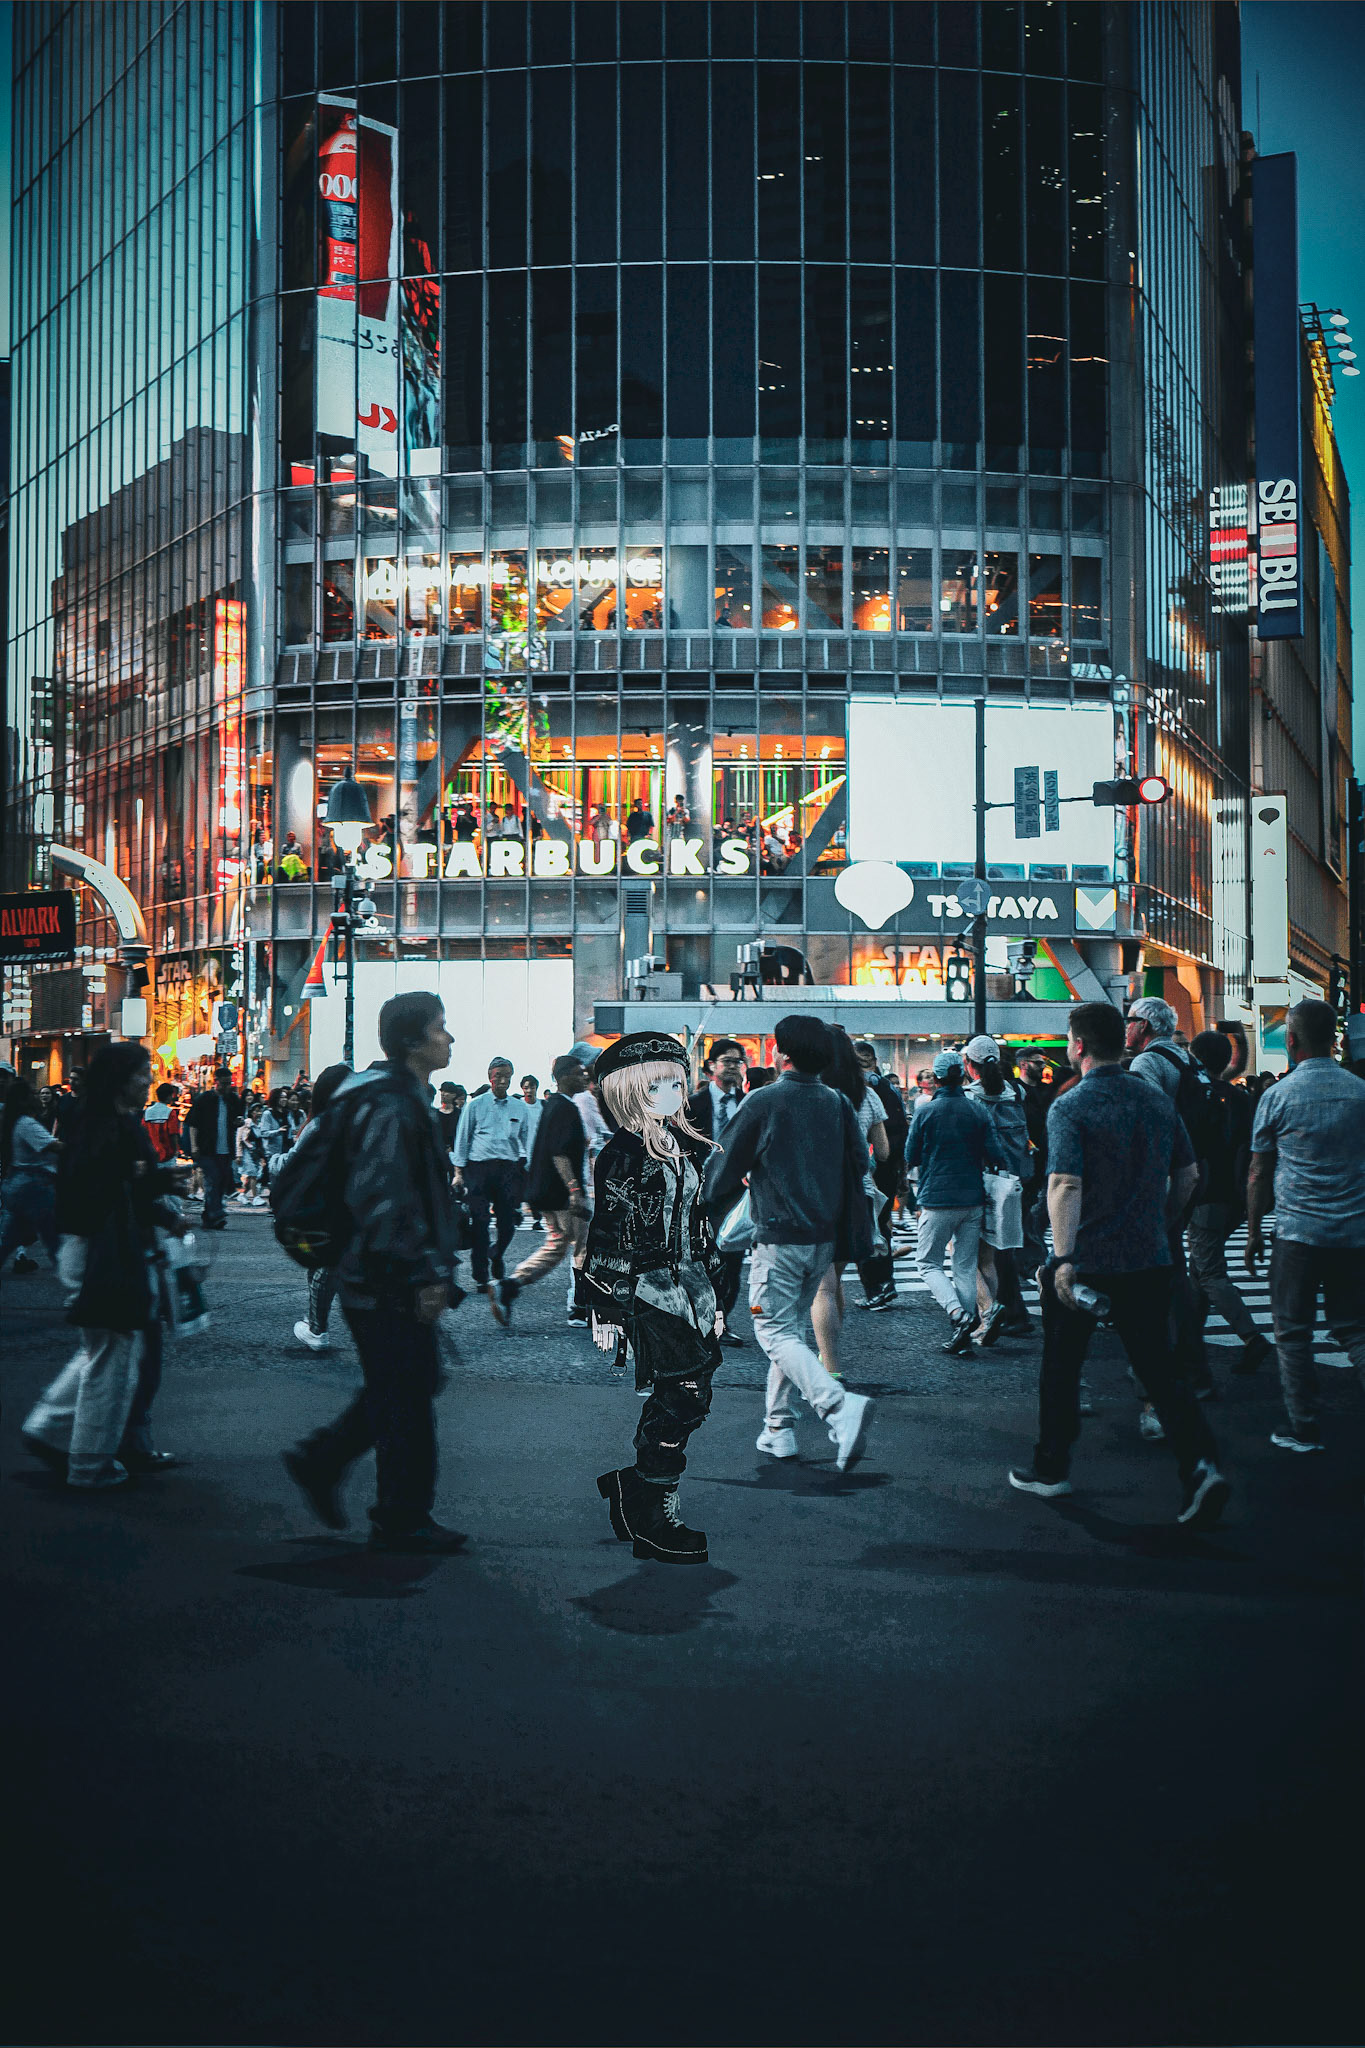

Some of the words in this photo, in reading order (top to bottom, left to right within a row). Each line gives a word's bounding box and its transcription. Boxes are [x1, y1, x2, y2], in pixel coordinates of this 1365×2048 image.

[1258, 478, 1298, 613] SEIBU
[537, 557, 662, 583] LOUNGE
[355, 838, 750, 880] STARBUCKS
[1, 905, 61, 937] ALVARK
[926, 894, 1059, 919] TSTAYA
[157, 960, 192, 983] STAR
